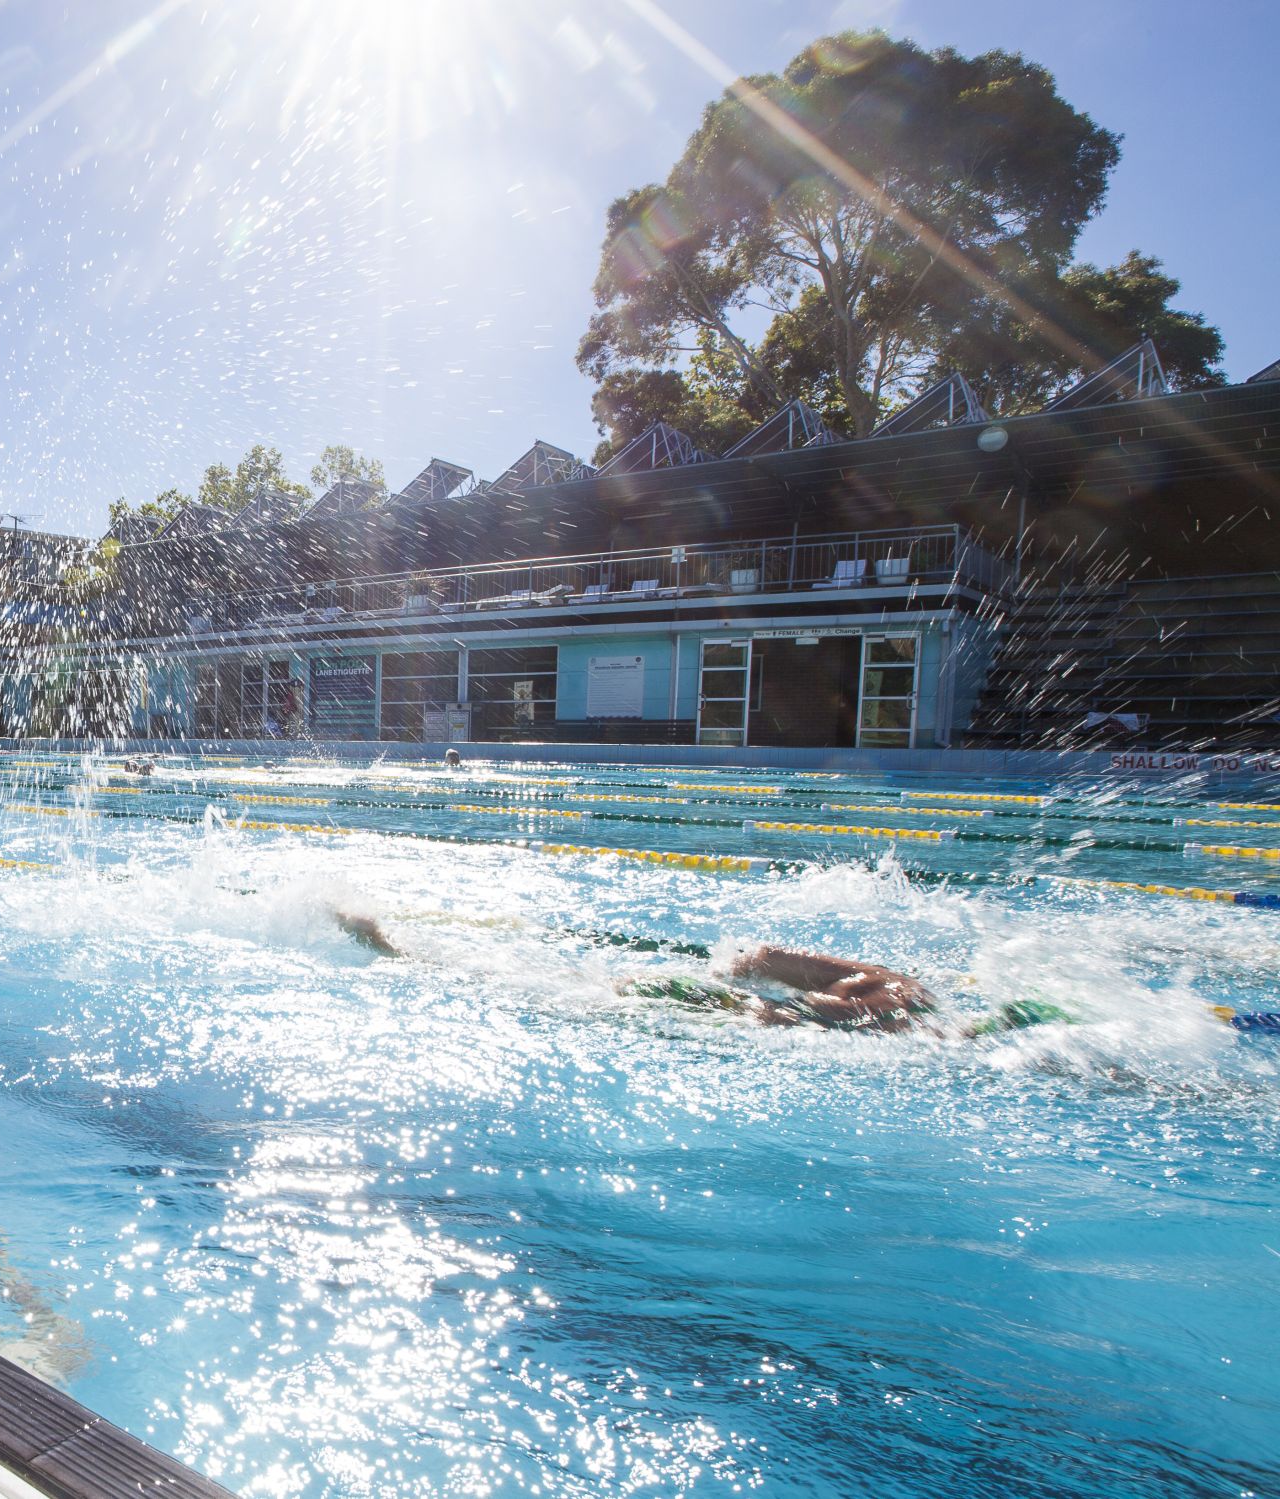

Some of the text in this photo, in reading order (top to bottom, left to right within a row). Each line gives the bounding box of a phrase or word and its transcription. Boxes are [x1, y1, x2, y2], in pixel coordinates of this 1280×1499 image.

[333, 667, 370, 676] ETIQUETTE
[1111, 755, 1200, 769] SHALLOW
[1213, 757, 1239, 771] DO
